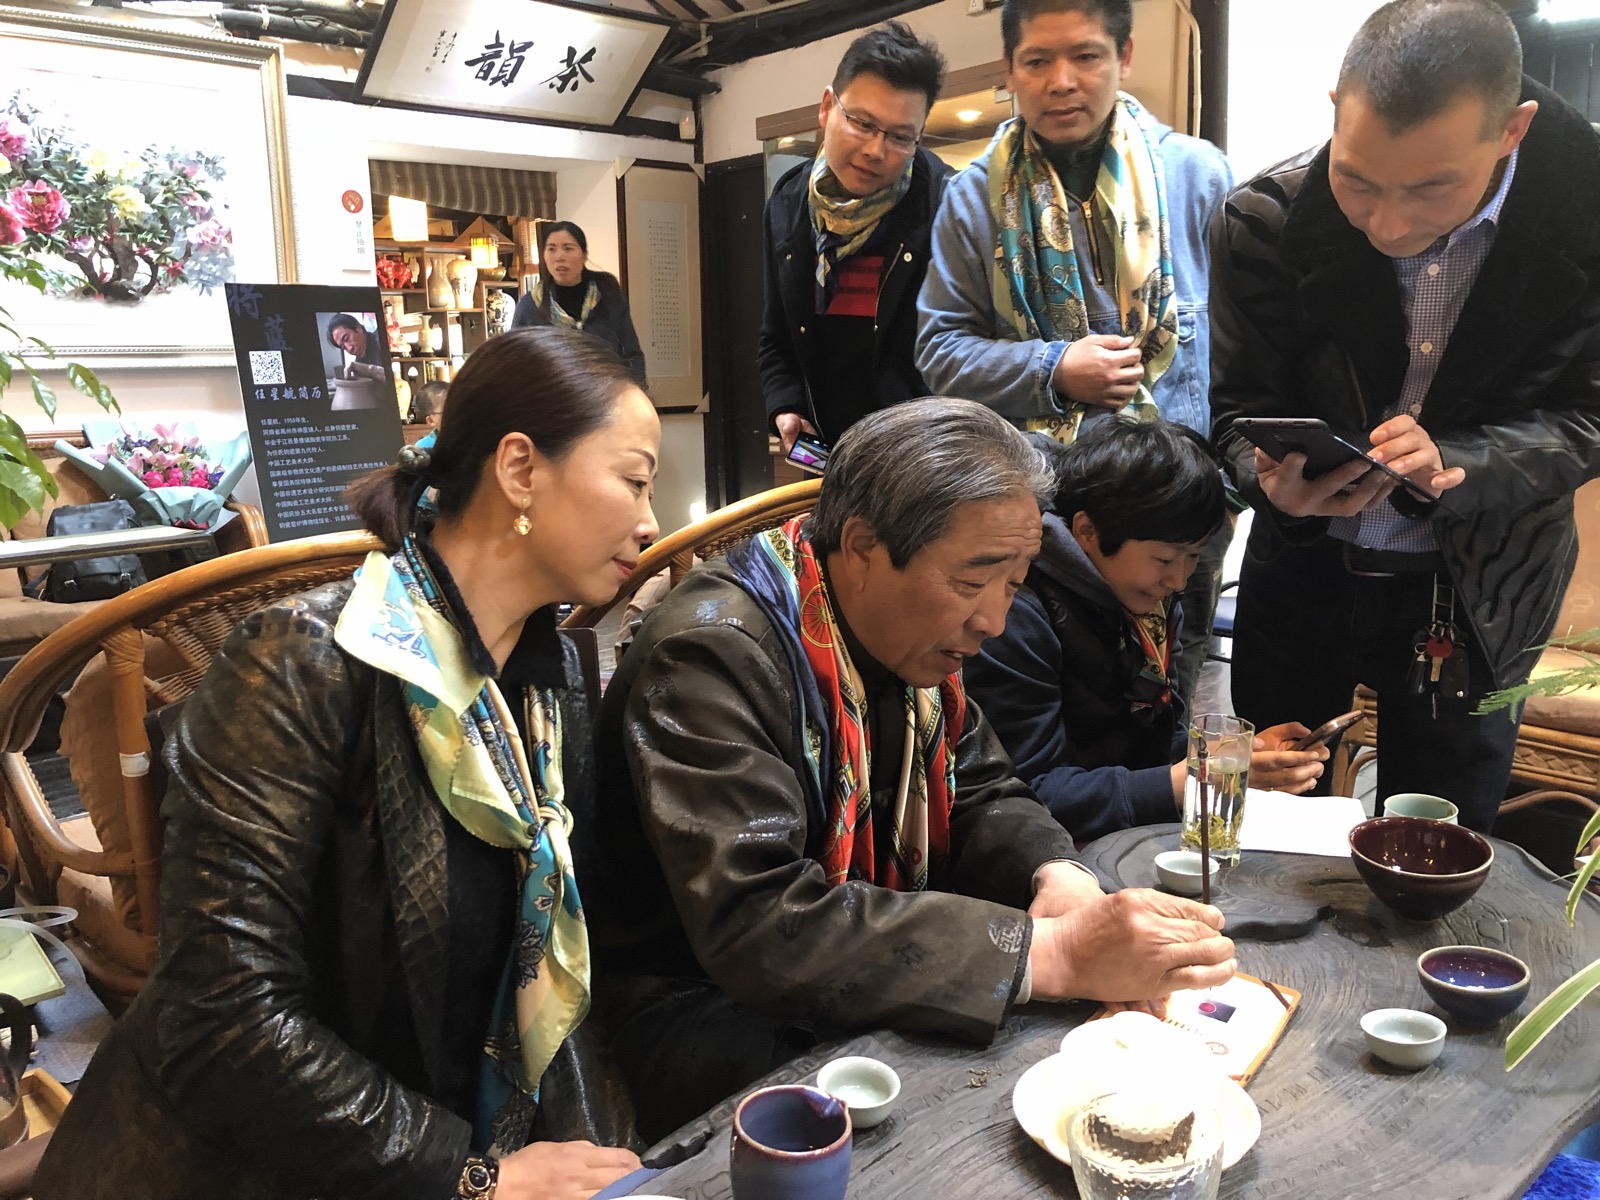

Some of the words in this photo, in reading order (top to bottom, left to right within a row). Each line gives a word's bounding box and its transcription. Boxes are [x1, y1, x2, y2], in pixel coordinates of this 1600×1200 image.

[255, 386, 321, 400] 任星航简历
